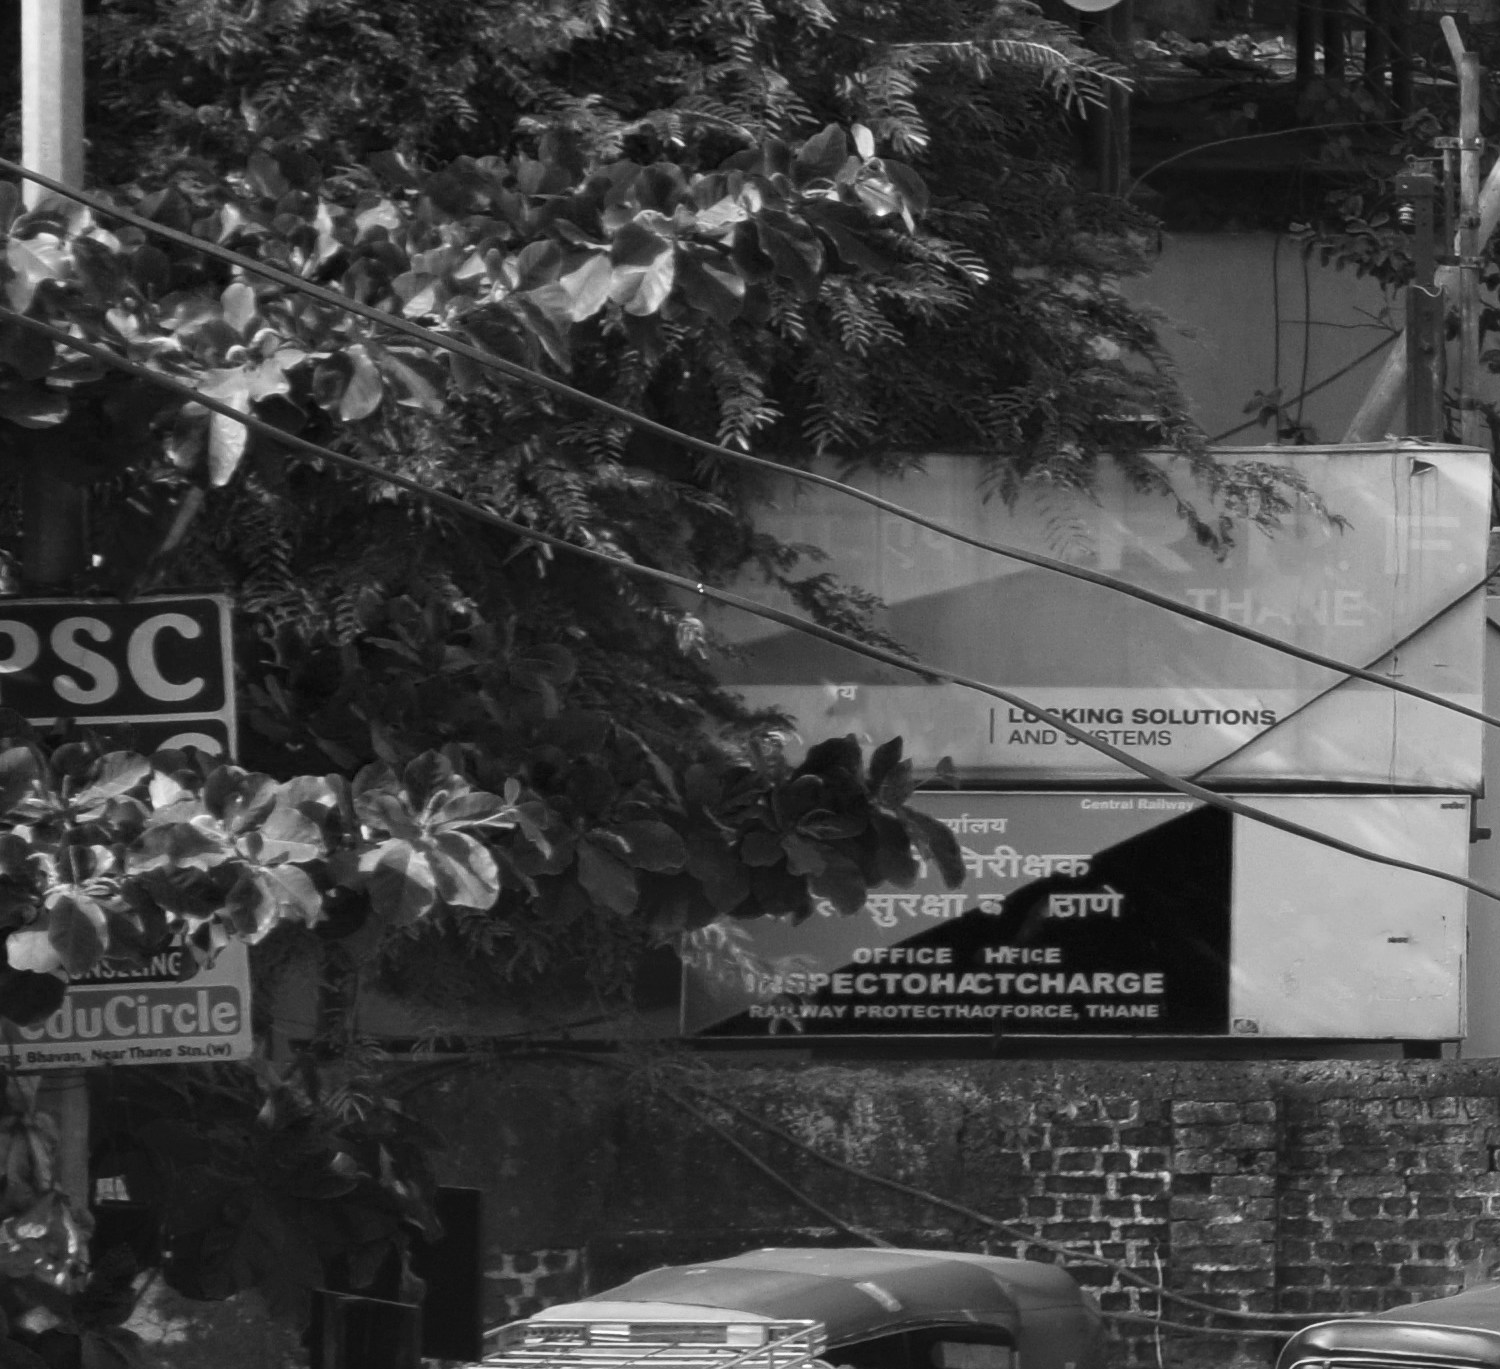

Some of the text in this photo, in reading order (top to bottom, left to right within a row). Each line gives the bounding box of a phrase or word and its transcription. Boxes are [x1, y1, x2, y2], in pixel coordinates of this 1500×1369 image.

[1132, 708, 1277, 726] SOLUTIONS
[1008, 730, 1057, 746] AND
[1081, 799, 1197, 813] Central Railway
[852, 947, 953, 964] OFFICE
[1087, 1004, 1160, 1019] THANE
